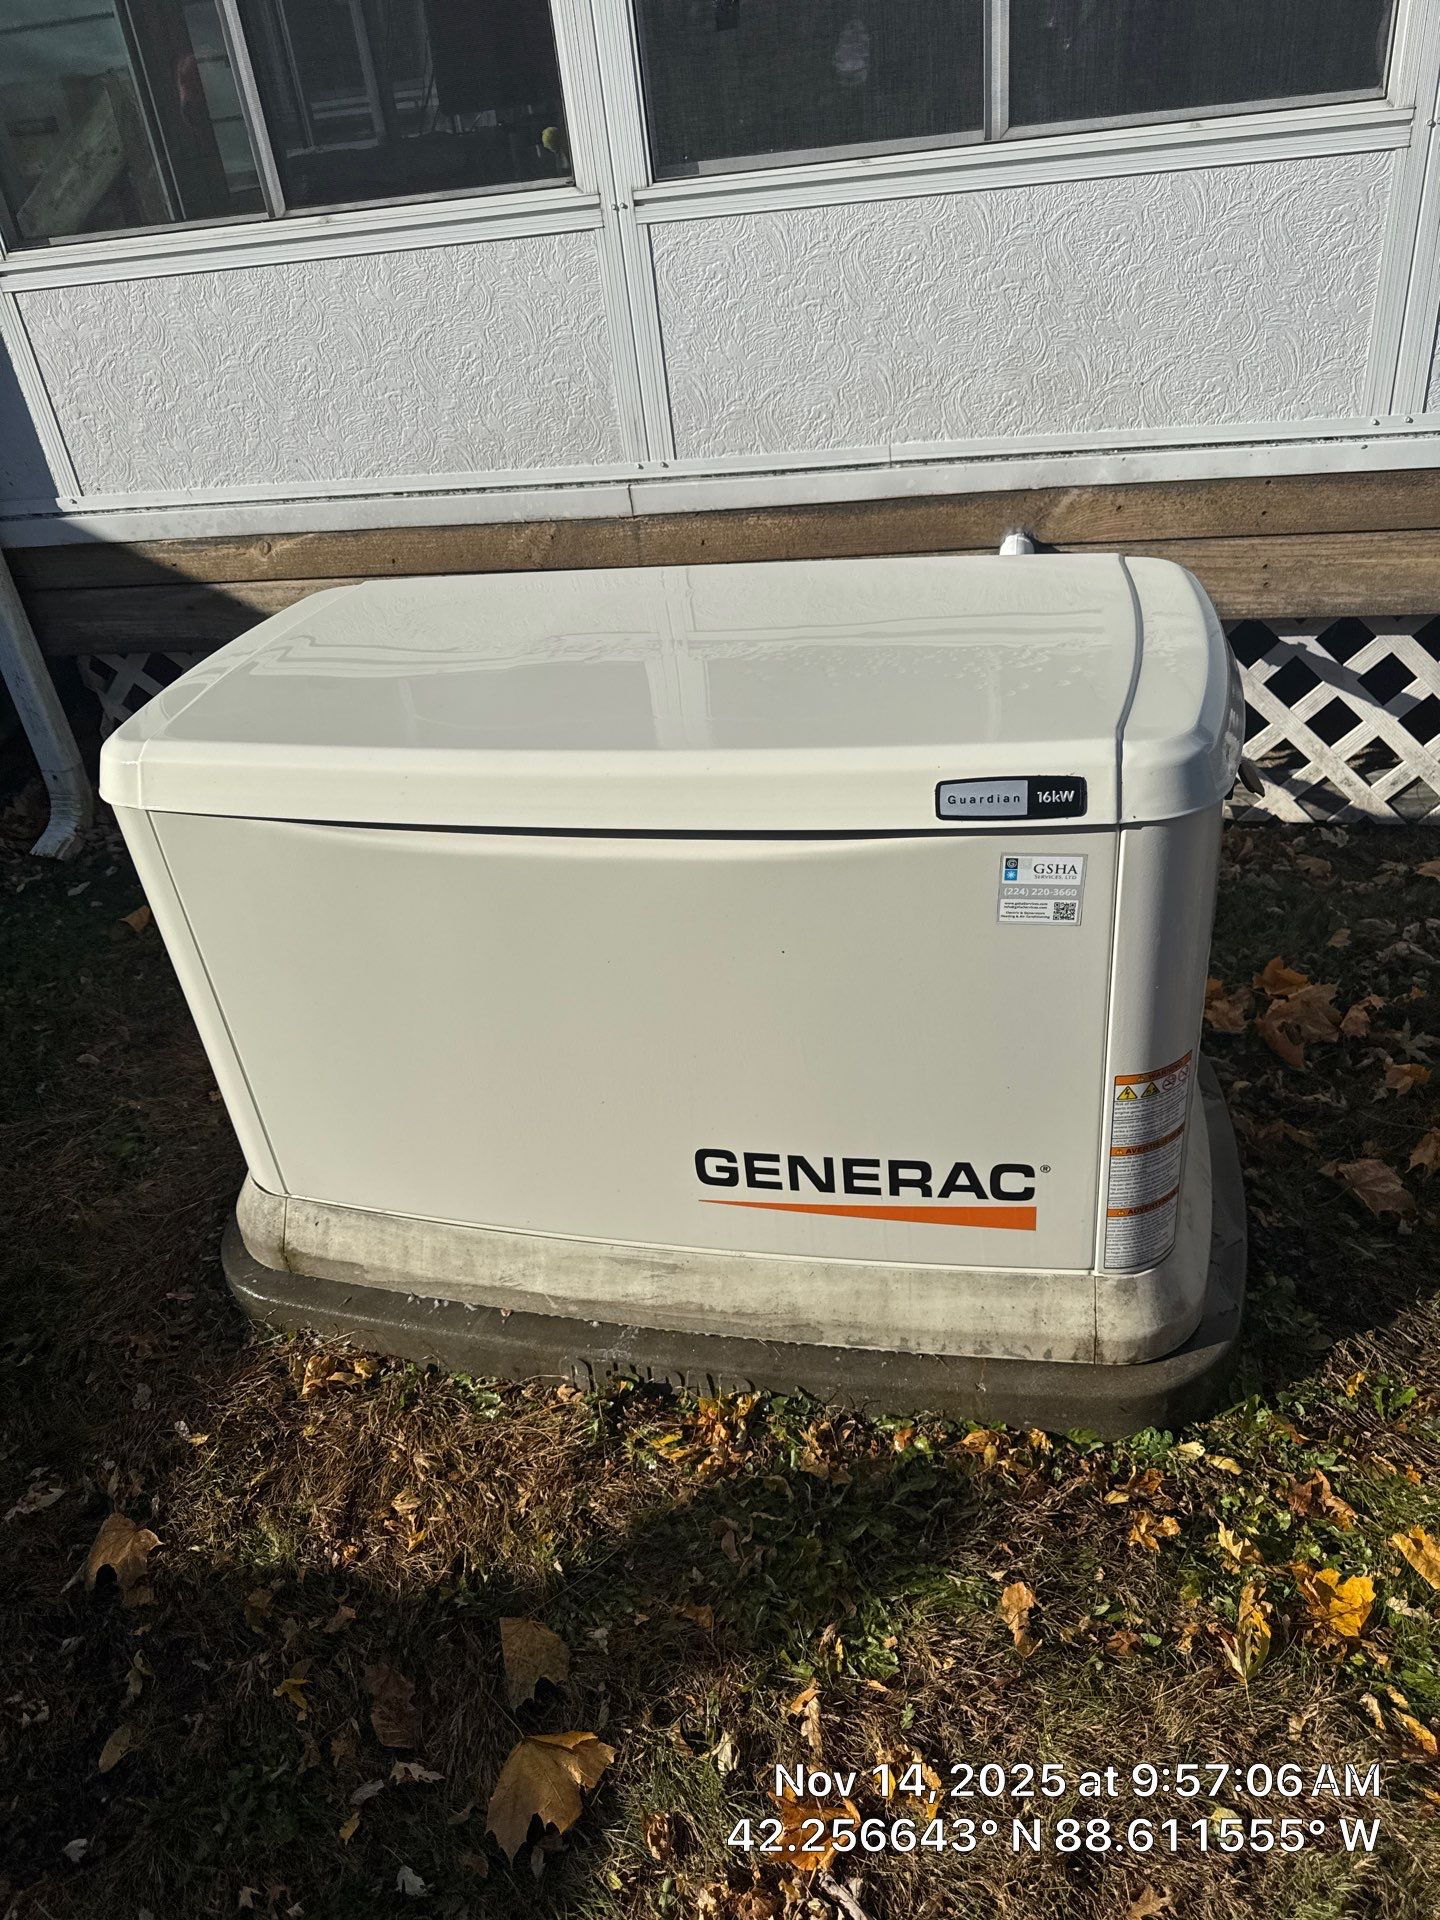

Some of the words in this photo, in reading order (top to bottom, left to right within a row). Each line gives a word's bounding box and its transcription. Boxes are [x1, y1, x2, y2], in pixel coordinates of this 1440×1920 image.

[947, 793, 1021, 805] Guardian
[1036, 790, 1075, 803] 16kW
[1033, 863, 1078, 875] GSHA
[1004, 887, 1029, 897] (224)
[1031, 888, 1077, 897] 220-3660
